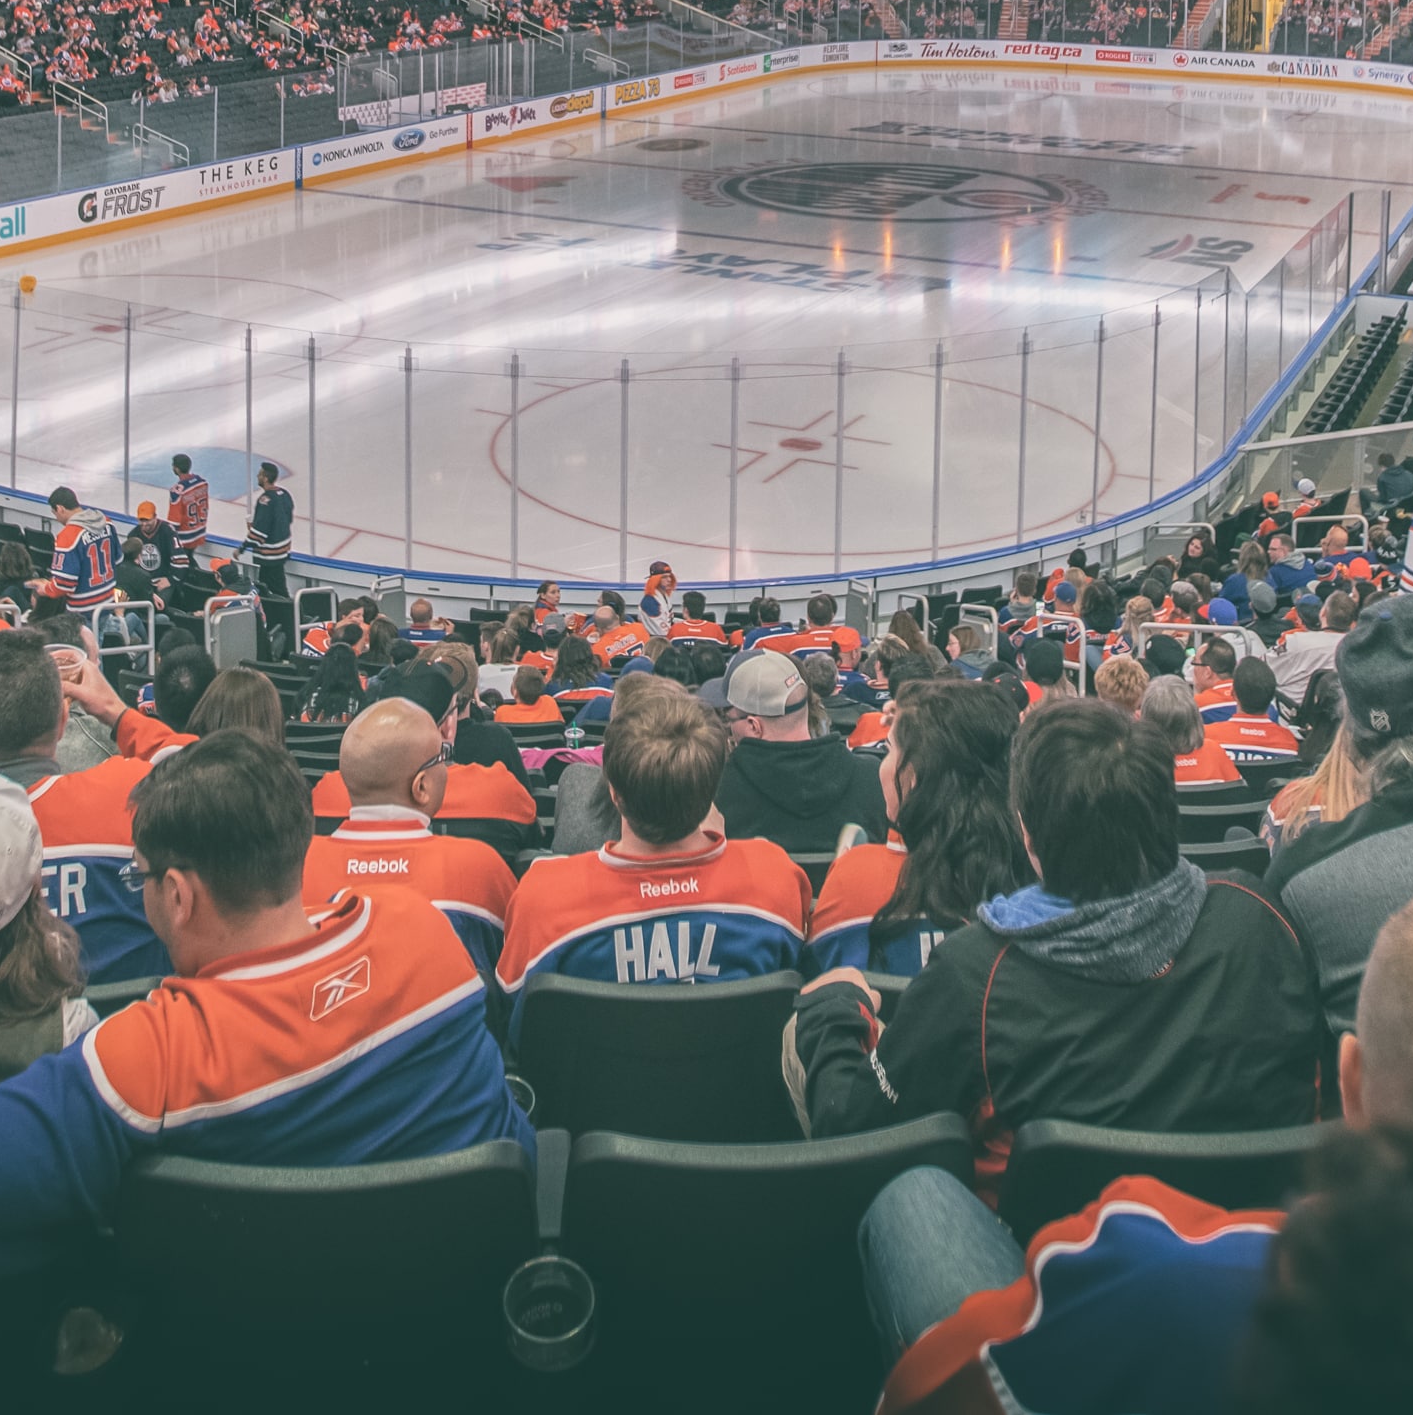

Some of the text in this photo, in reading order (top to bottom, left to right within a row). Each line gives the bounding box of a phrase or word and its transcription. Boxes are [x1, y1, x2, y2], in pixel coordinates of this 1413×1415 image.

[920, 42, 945, 58] Tim
[1190, 56, 1256, 69] AIR CANADA
[1281, 61, 1338, 77] CANADIAN
[1368, 68, 1404, 83] Synergy
[566, 90, 595, 114] depot
[615, 77, 661, 105] PIZZA 73
[322, 141, 385, 164] KONICA MINOLTA
[396, 133, 422, 149] Ford
[200, 165, 233, 185] THE
[244, 155, 279, 176] KEG
[104, 182, 140, 197] GATORADE
[101, 186, 166, 220] FROST
[187, 497, 208, 528] 93
[87, 538, 115, 587] 11
[347, 856, 409, 877] Reebok
[639, 875, 700, 899] Reebok
[613, 919, 721, 984] HALL
